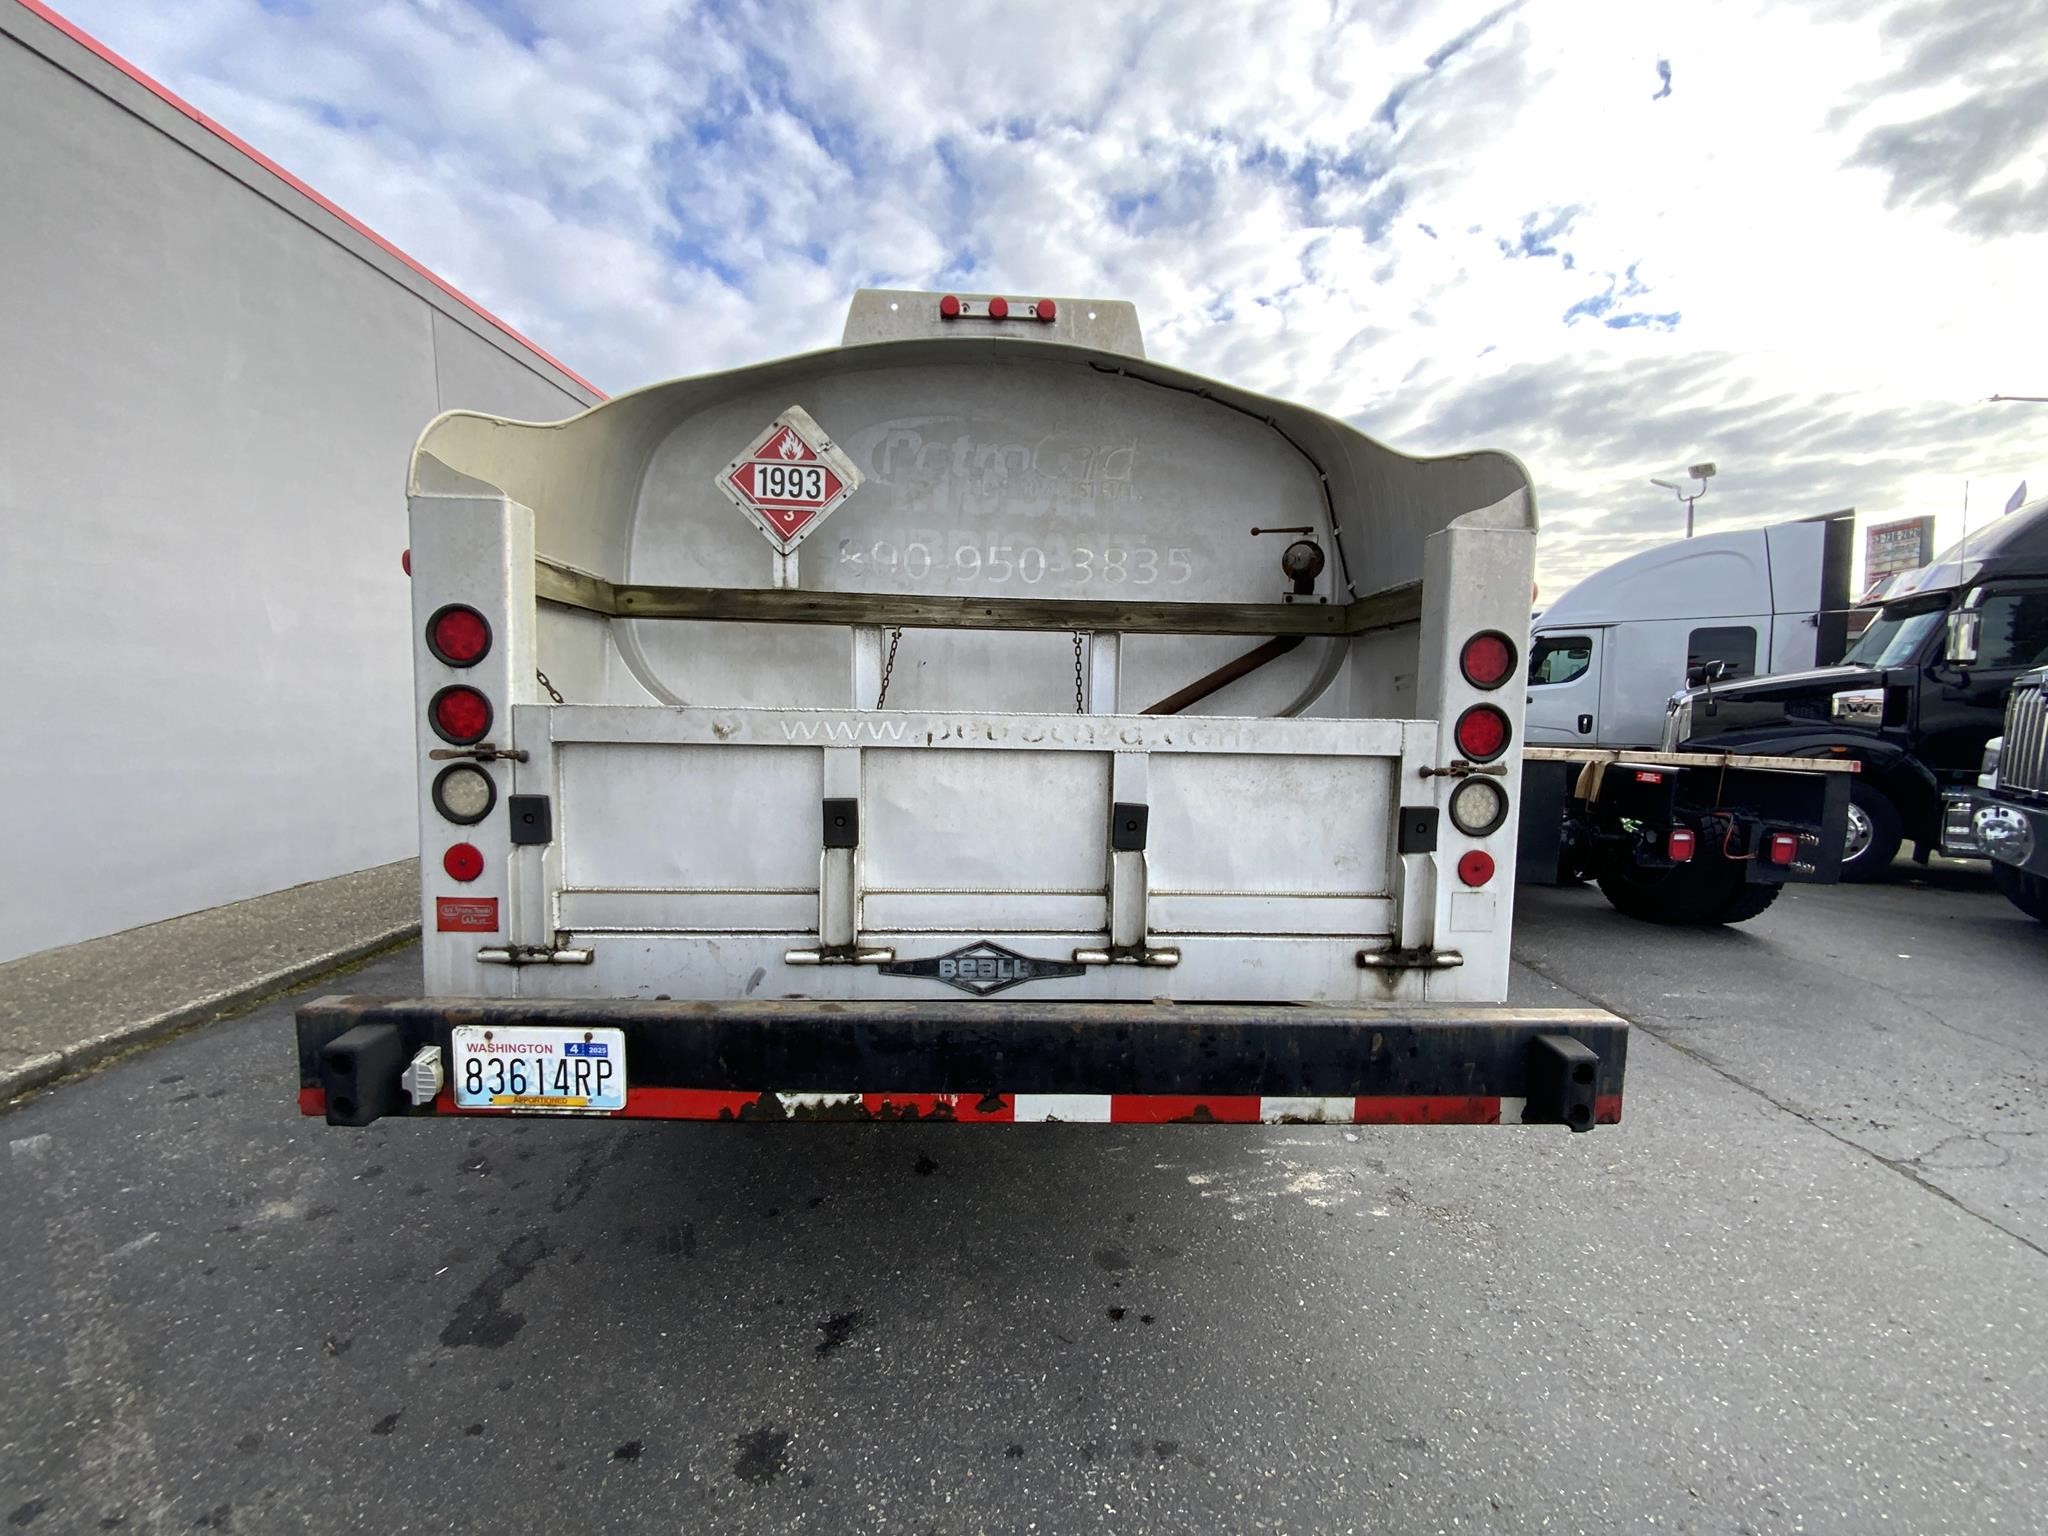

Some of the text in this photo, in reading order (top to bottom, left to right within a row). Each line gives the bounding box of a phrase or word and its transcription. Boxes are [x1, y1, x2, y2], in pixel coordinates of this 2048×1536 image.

[758, 466, 822, 500] 1993
[783, 510, 795, 522] 3
[466, 1043, 553, 1054] WASHINGTON
[569, 1043, 579, 1054] 4
[465, 1057, 613, 1096] 83614RP
[512, 1096, 568, 1105] APPORTIONED
